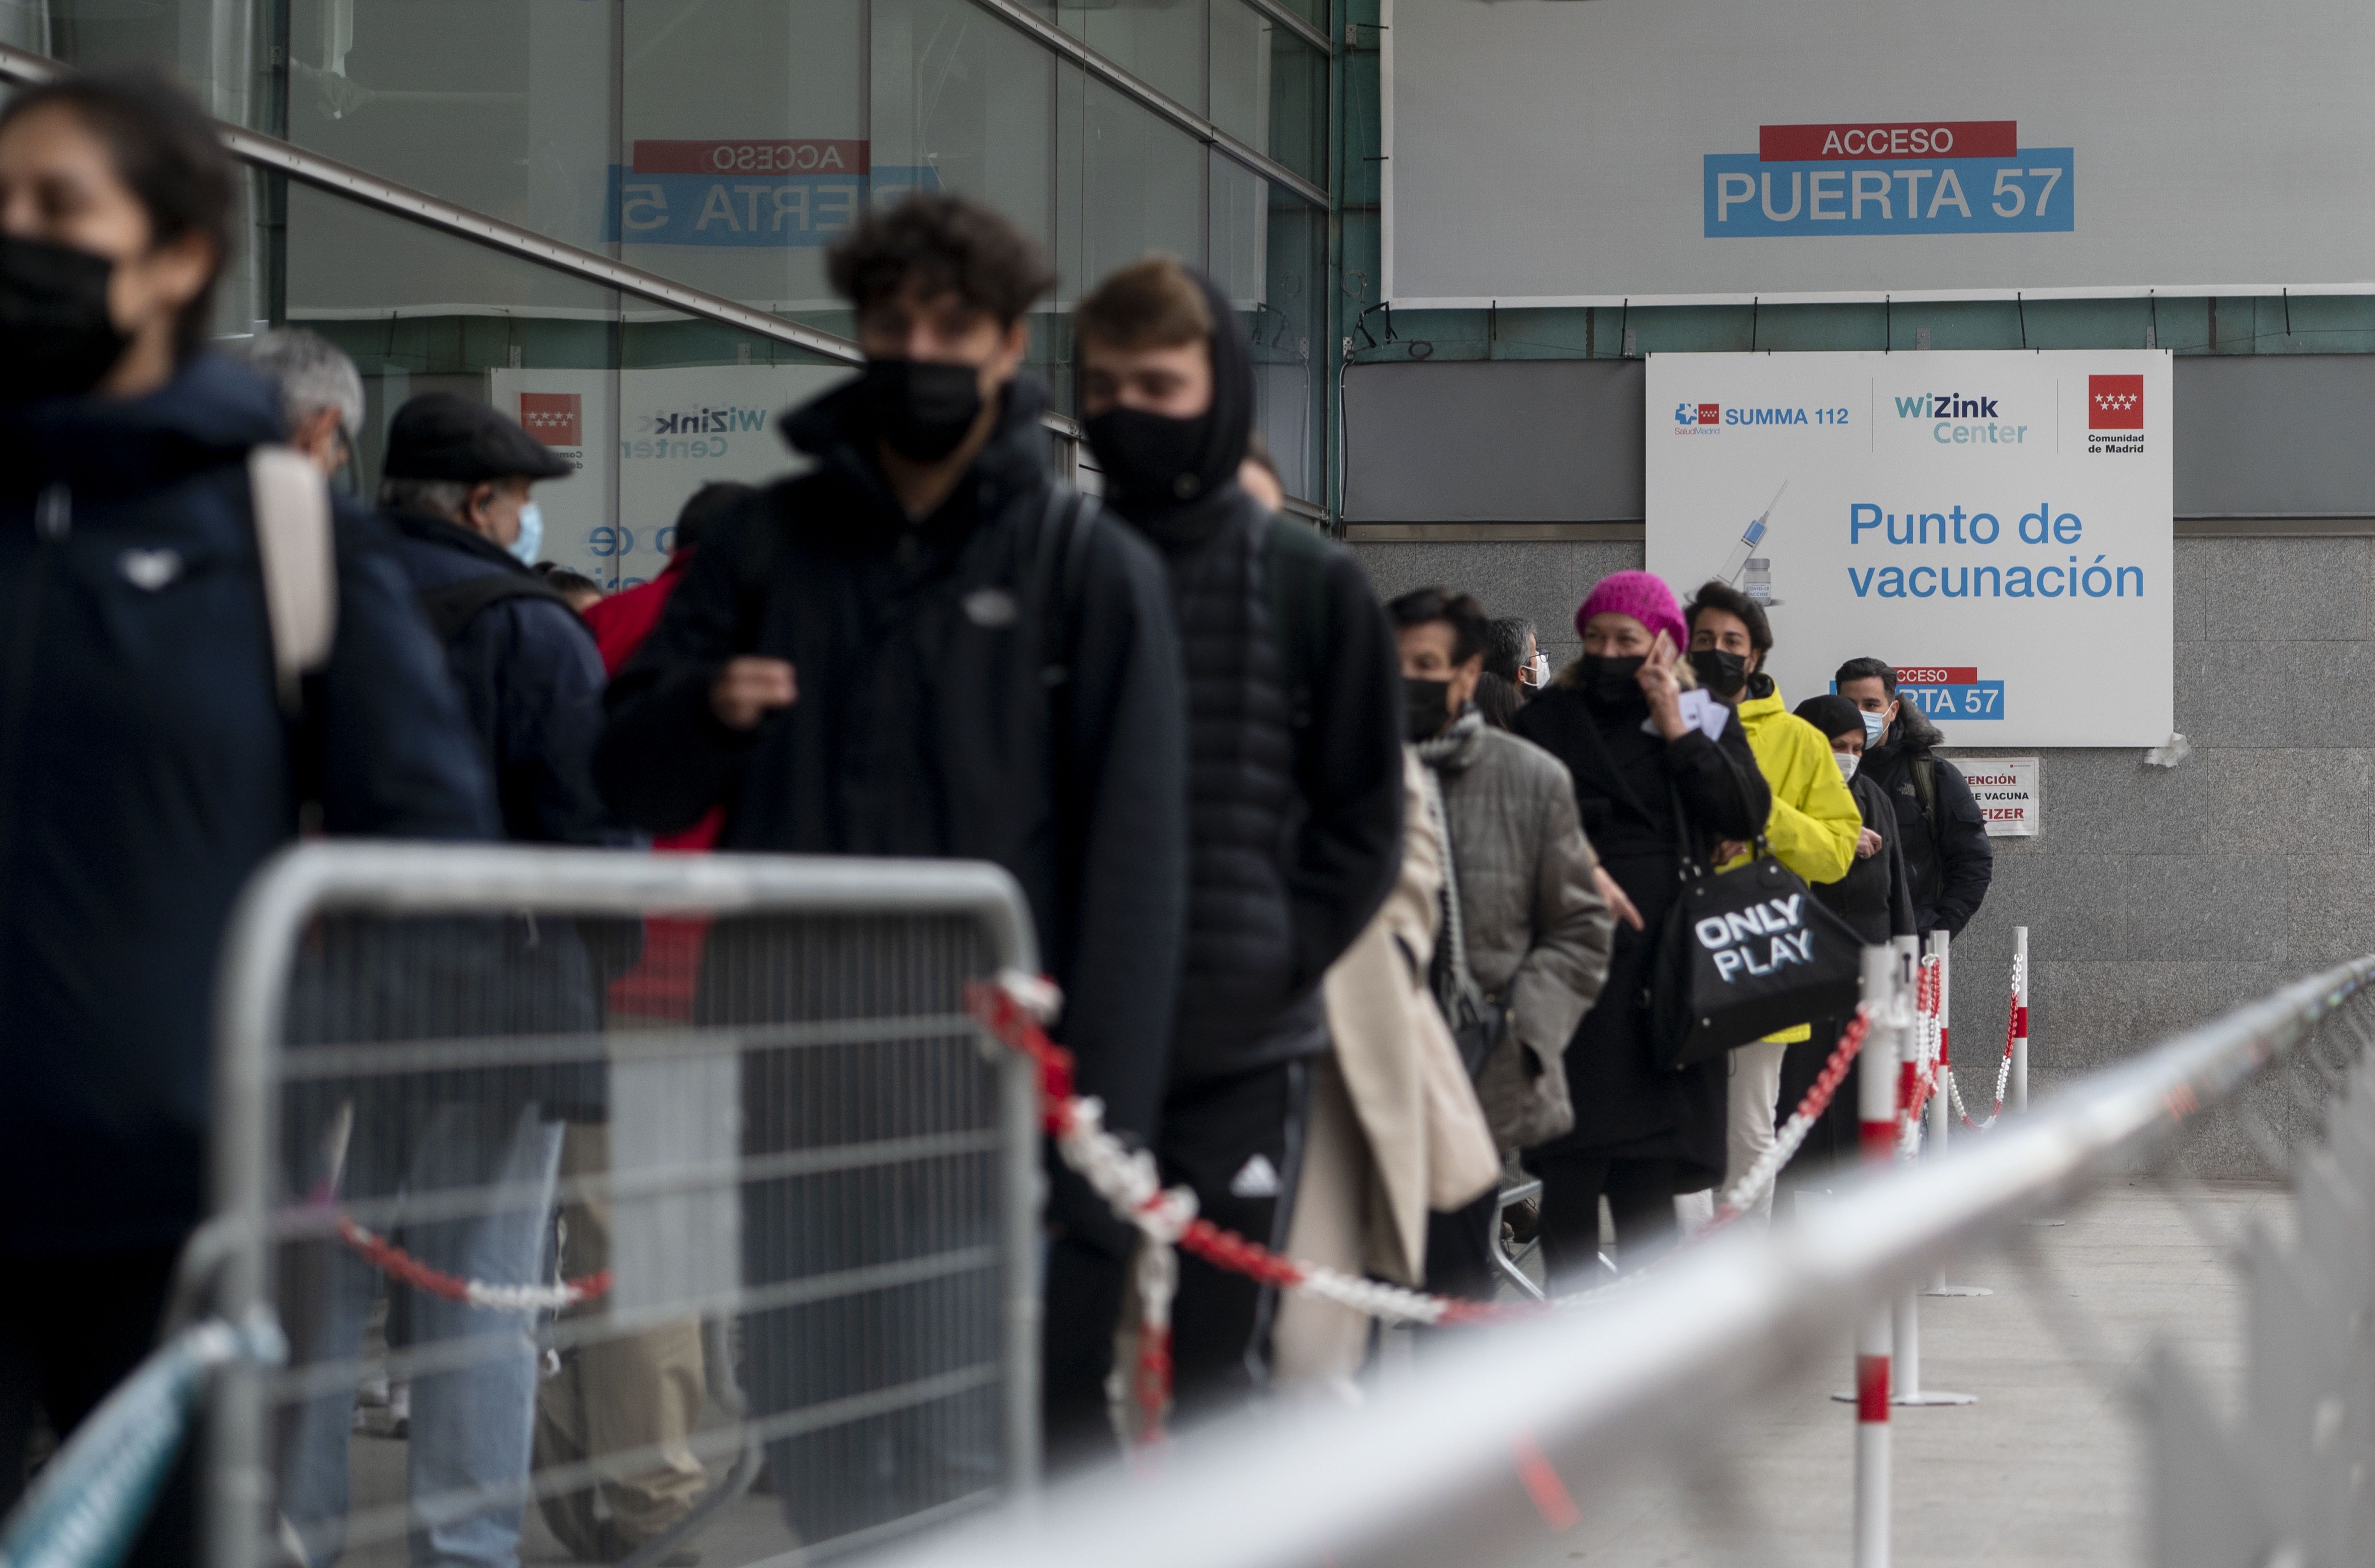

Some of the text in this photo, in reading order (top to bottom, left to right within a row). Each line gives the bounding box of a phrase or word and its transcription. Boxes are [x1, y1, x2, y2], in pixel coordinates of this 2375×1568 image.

[1821, 128, 1953, 155] ACCESO
[1717, 168, 2062, 222] PUERTA 57
[1725, 408, 1848, 425] SUMMA 112
[1895, 392, 1999, 418] WiZink
[1933, 422, 2027, 444] Center
[2088, 445, 2144, 453] de Madrid
[1851, 503, 2082, 544] Punto de
[1848, 555, 2144, 598] vacunación
[1897, 670, 1947, 682] CCESO
[1965, 690, 1999, 713] 57
[1980, 808, 2024, 819] FIZER
[1695, 893, 1804, 948] ONLY
[1713, 929, 1813, 982] PLAY
